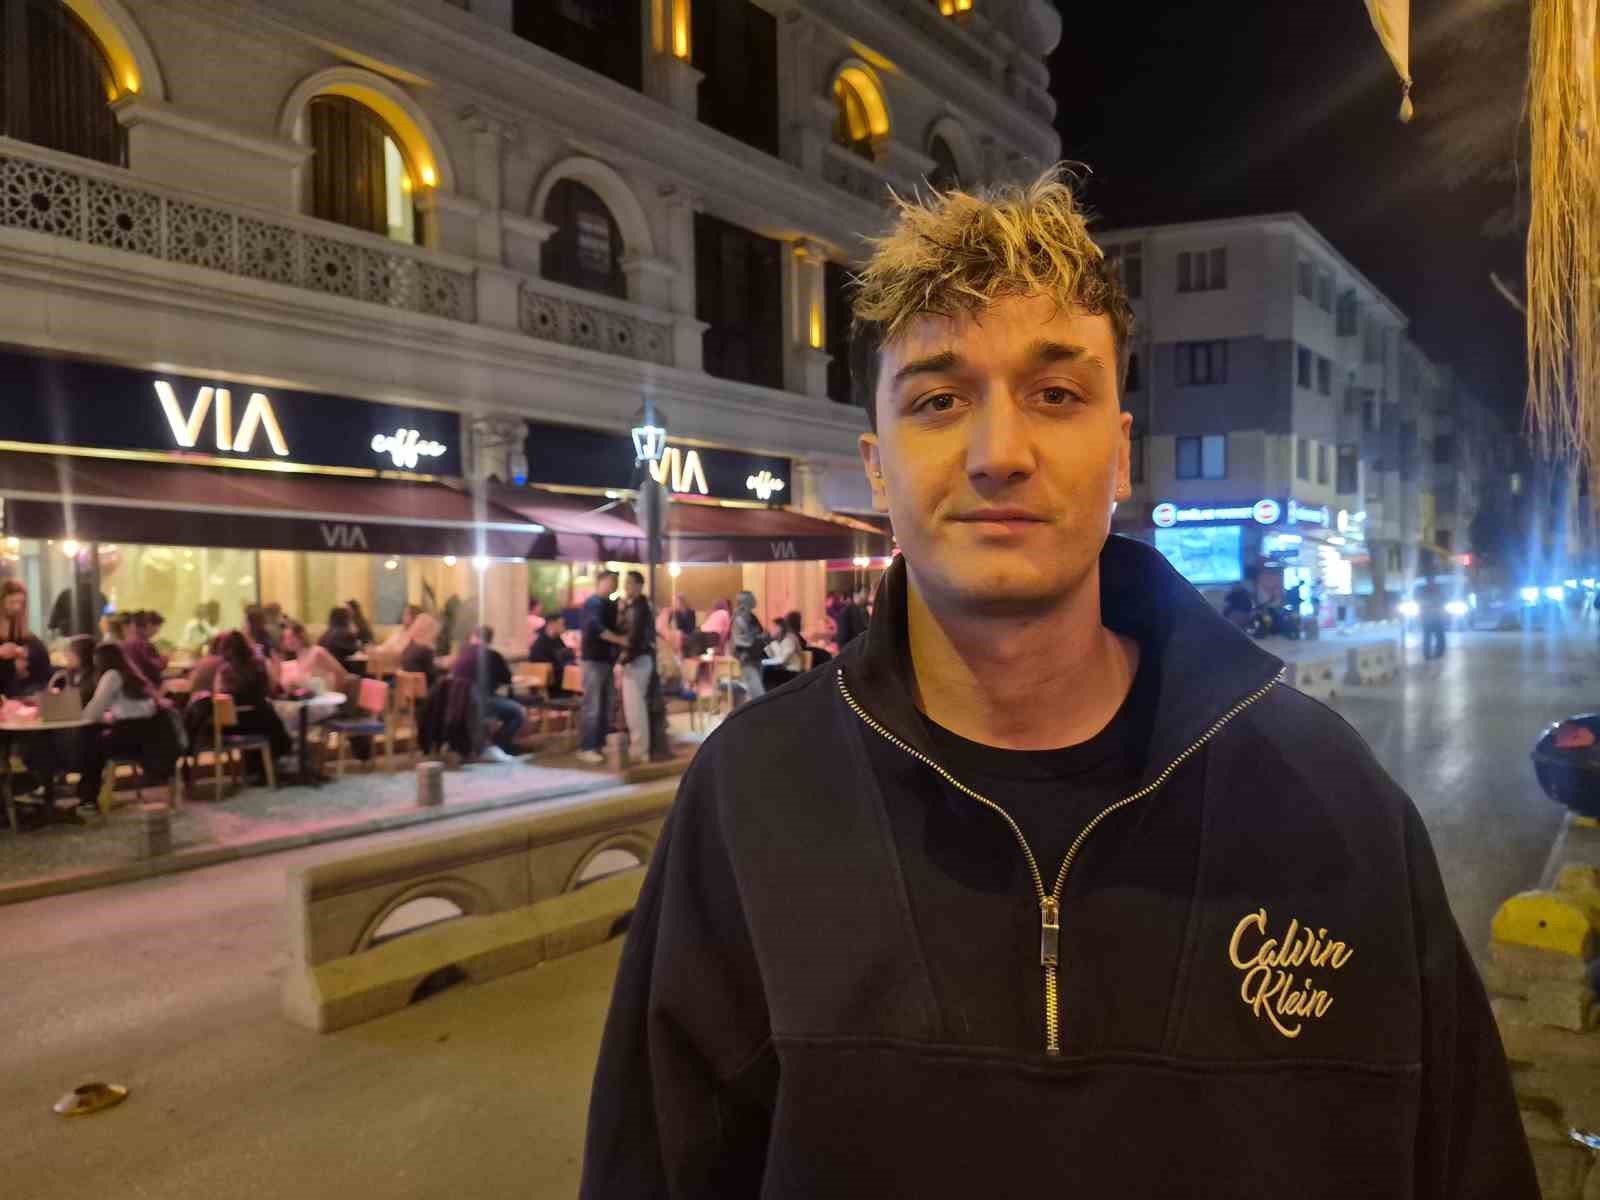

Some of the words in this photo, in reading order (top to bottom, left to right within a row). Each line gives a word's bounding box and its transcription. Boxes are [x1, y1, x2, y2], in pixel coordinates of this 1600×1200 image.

[154, 381, 289, 455] VIA
[371, 428, 447, 468] coffee
[321, 522, 367, 549] VIA
[771, 541, 798, 558] VIA
[1229, 908, 1353, 969] Calvin
[1241, 965, 1333, 1038] Klein
